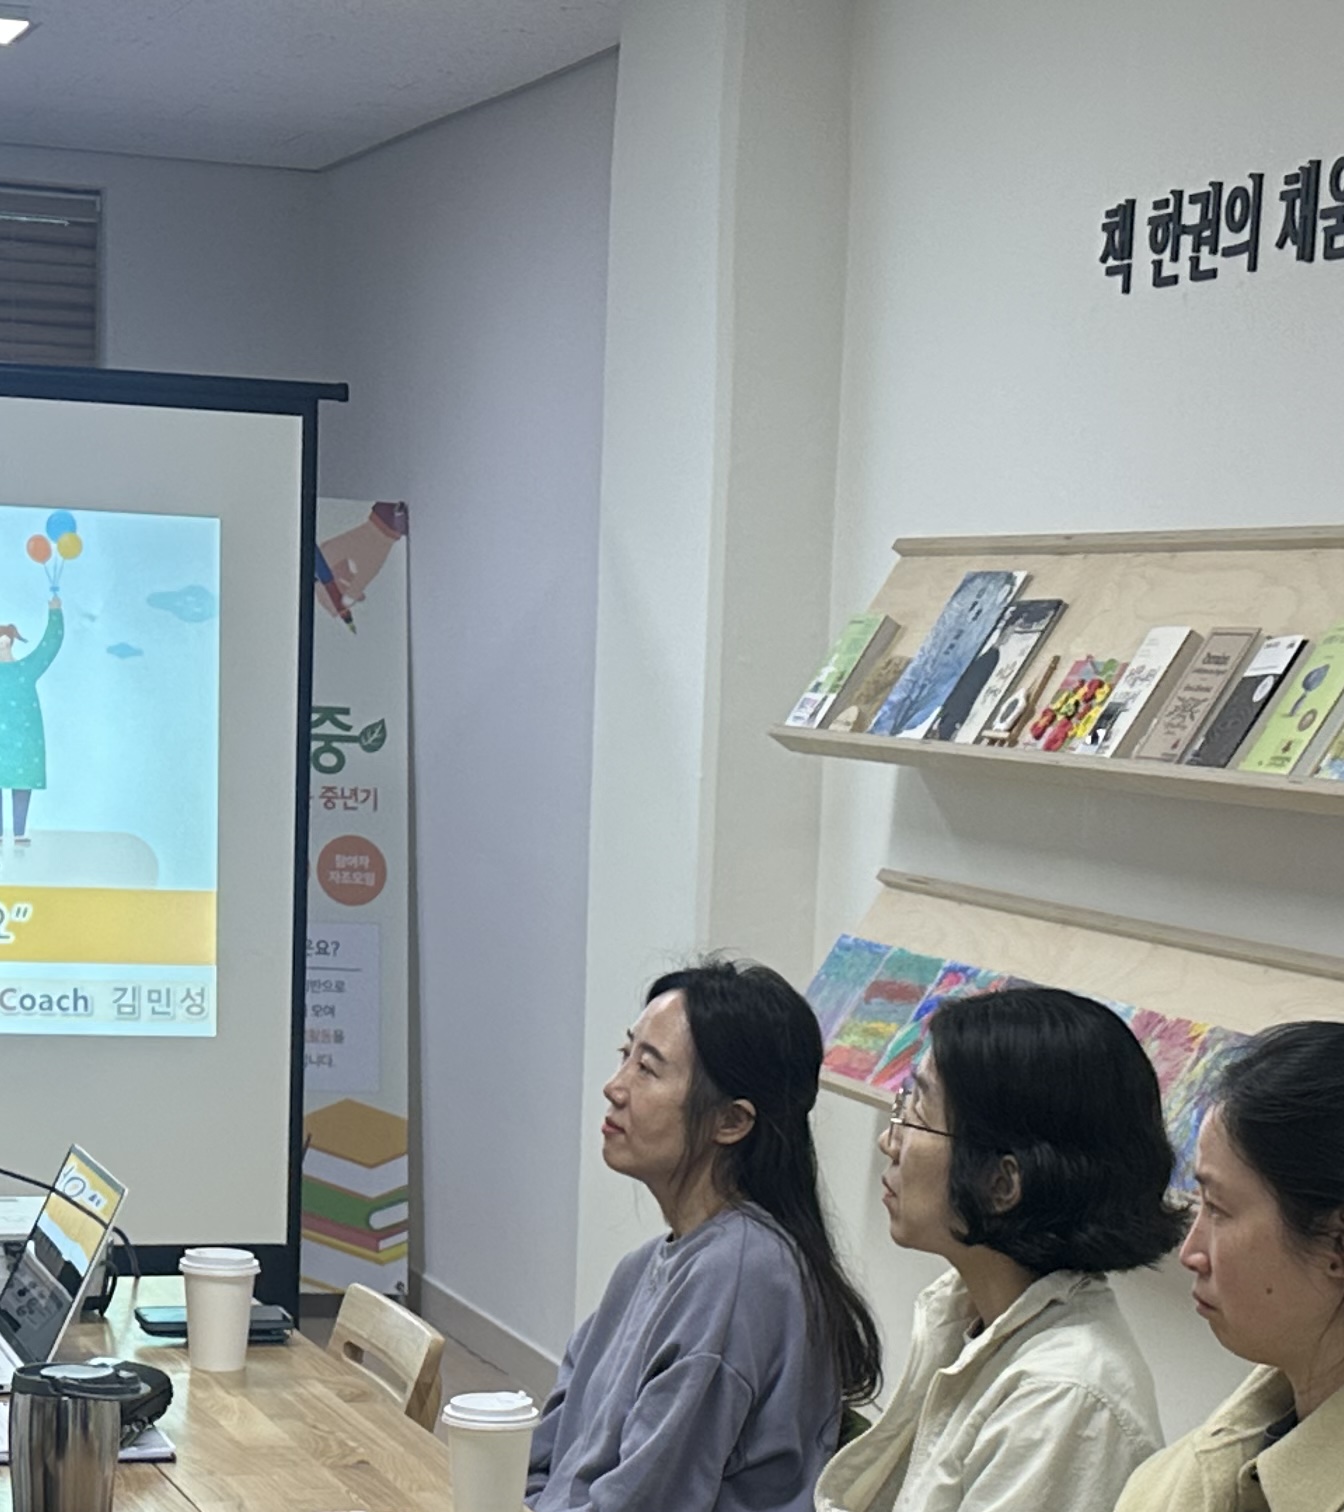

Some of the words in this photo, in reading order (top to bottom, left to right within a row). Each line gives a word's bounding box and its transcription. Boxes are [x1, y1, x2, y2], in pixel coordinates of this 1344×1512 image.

[1099, 198, 1136, 295] 책
[1147, 172, 1265, 288] 한권의
[318, 785, 378, 812] 중년기
[111, 986, 207, 1018] 김민성
